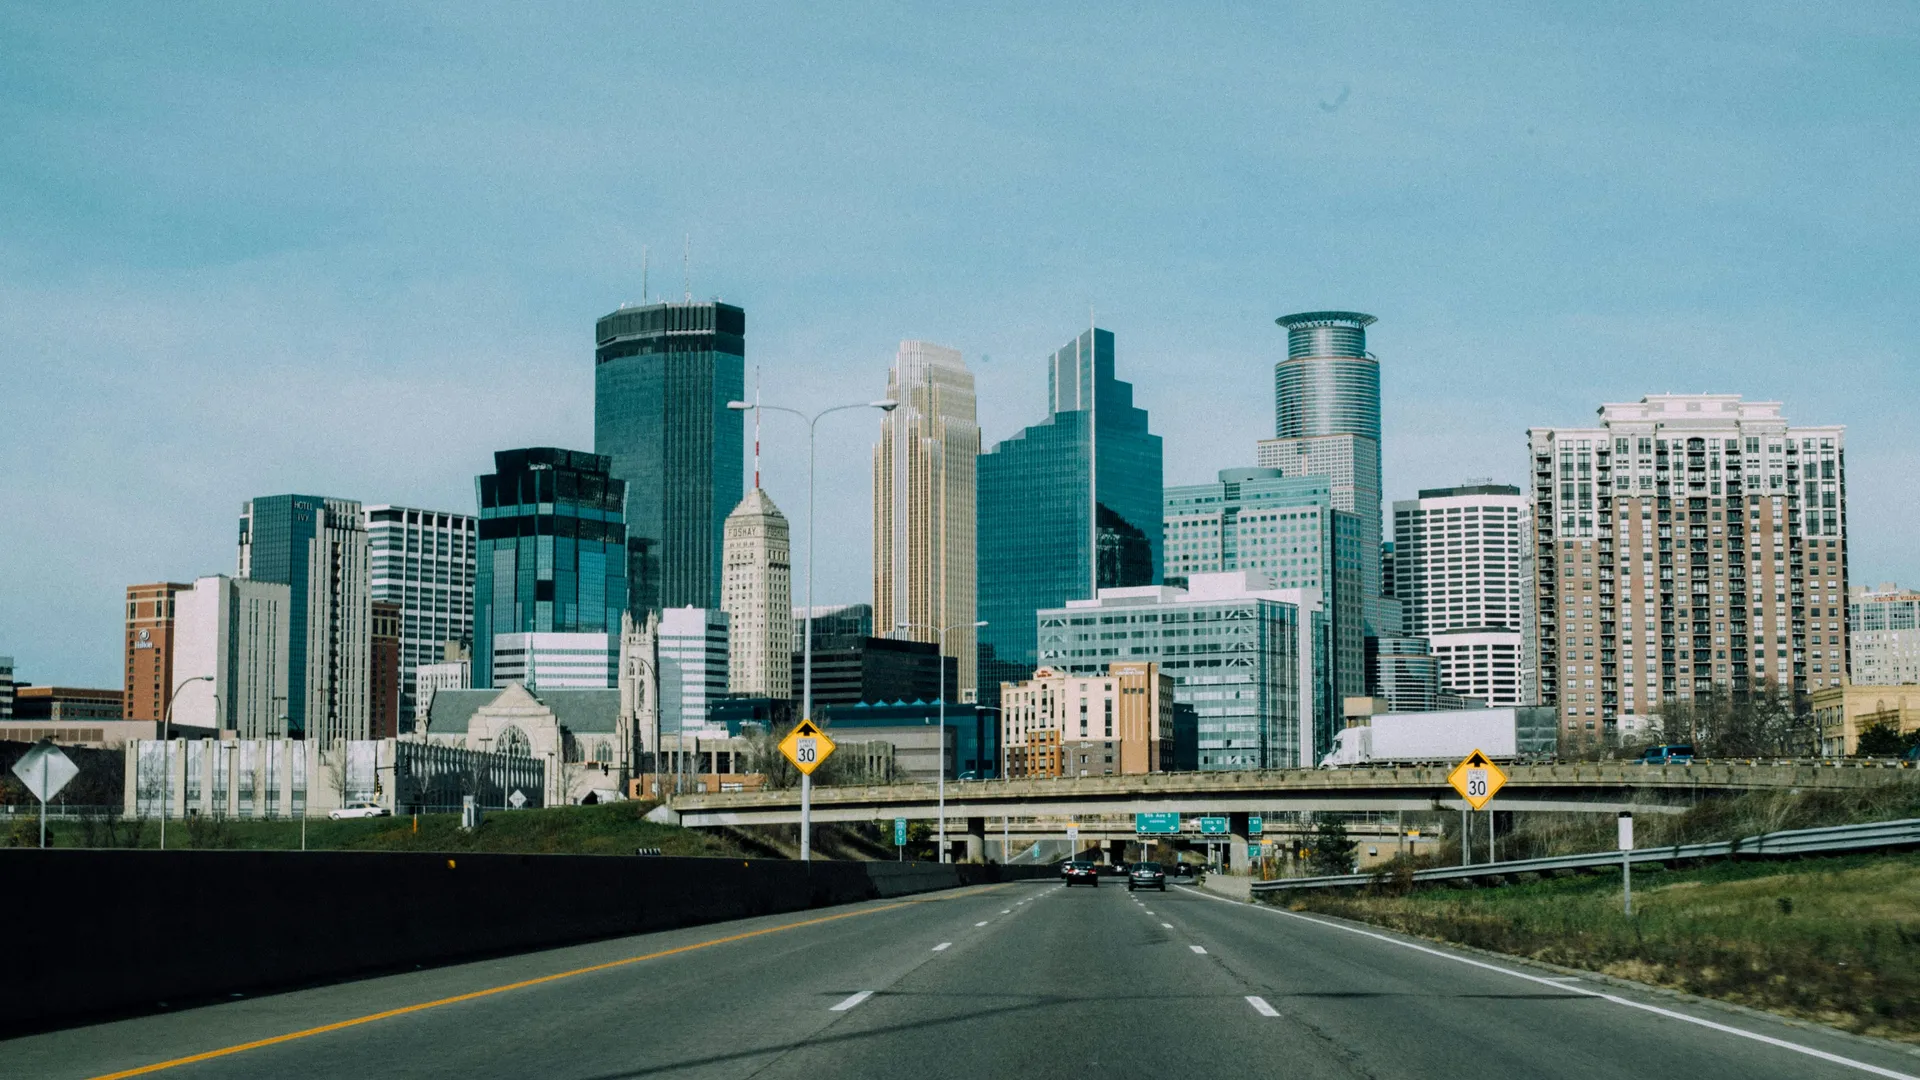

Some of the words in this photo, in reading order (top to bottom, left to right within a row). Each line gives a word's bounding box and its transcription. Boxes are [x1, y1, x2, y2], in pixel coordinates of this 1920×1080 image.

[294, 500, 312, 510] HOTEL
[298, 513, 310, 522] IVY
[728, 527, 756, 537] FOSHAY
[798, 748, 815, 762] 30
[1469, 780, 1486, 795] 30
